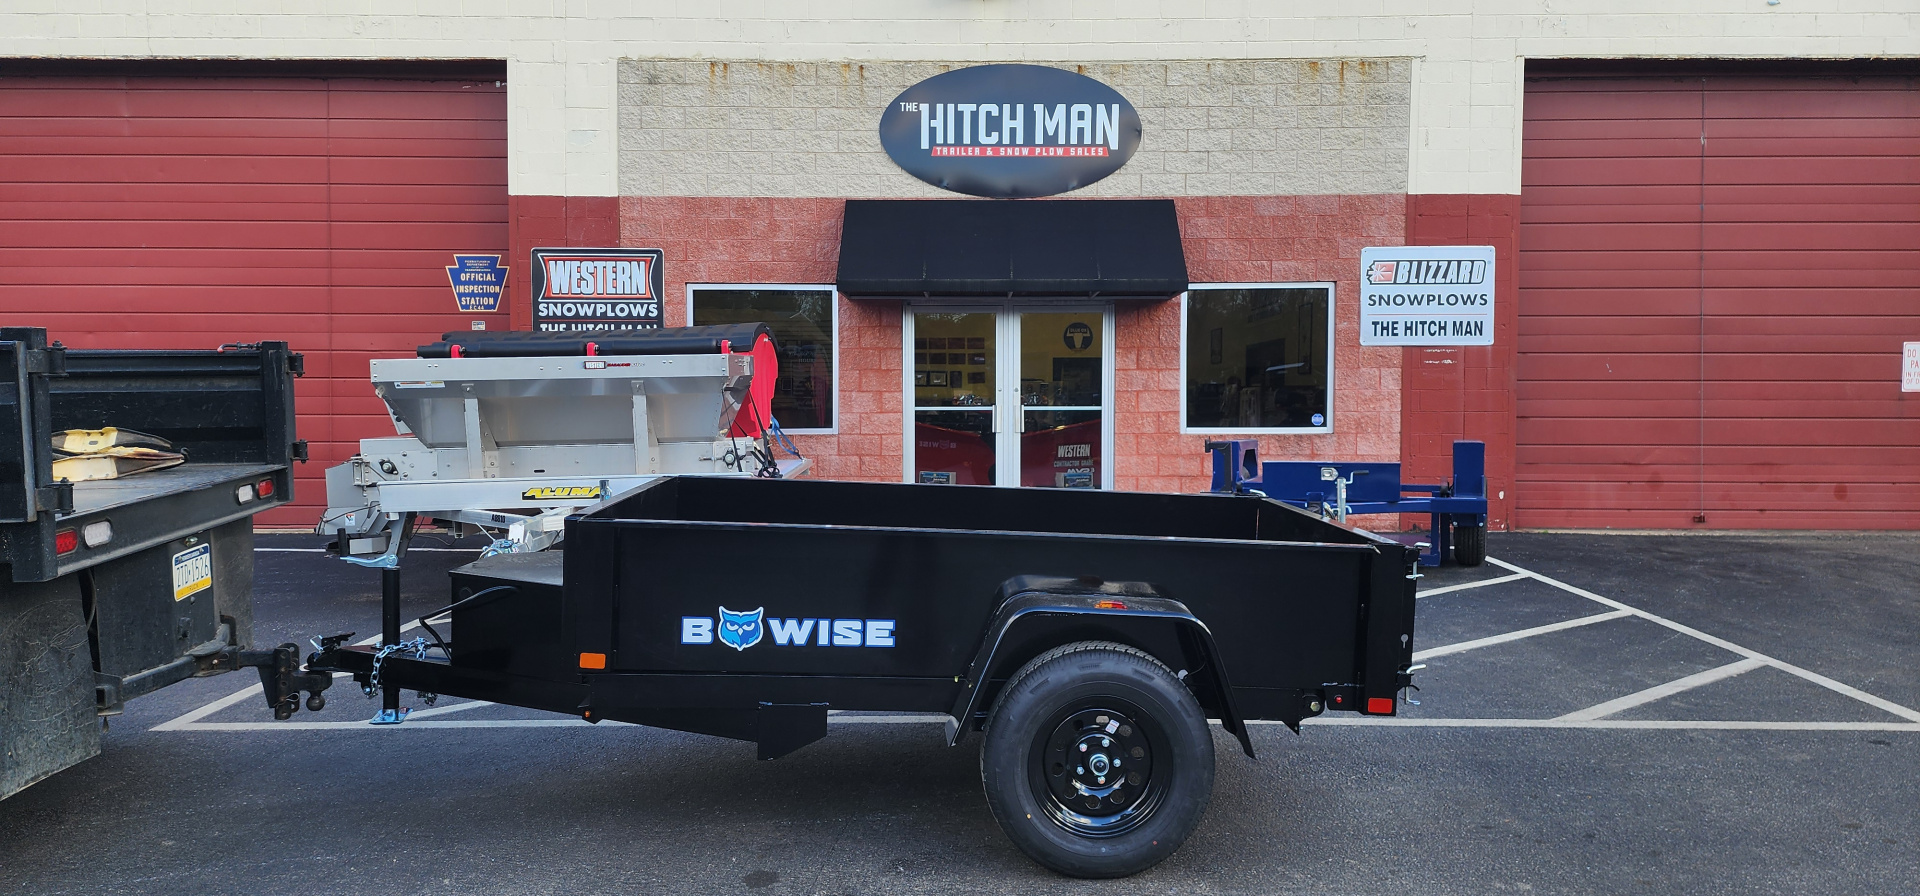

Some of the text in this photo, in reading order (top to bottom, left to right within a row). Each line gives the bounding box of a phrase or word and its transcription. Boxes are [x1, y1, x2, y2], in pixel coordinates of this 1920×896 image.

[900, 102, 918, 112] THE
[919, 103, 1120, 150] HITCH MAN
[936, 147, 1104, 156] TRAILER & SNOW PLOW SALES
[460, 273, 496, 281] OFFICIAL
[548, 260, 646, 295] WESTERN
[1395, 260, 1486, 284] BLIZZARD
[456, 285, 500, 293] INSPECTION
[461, 297, 494, 305] STATION
[1367, 294, 1488, 306] SNOWPLOWS
[538, 303, 658, 317] SNOWPLOWS
[1371, 320, 1483, 337] THE HITCH MAN
[1907, 349, 1916, 358] DO
[1057, 444, 1091, 458] WESTERN
